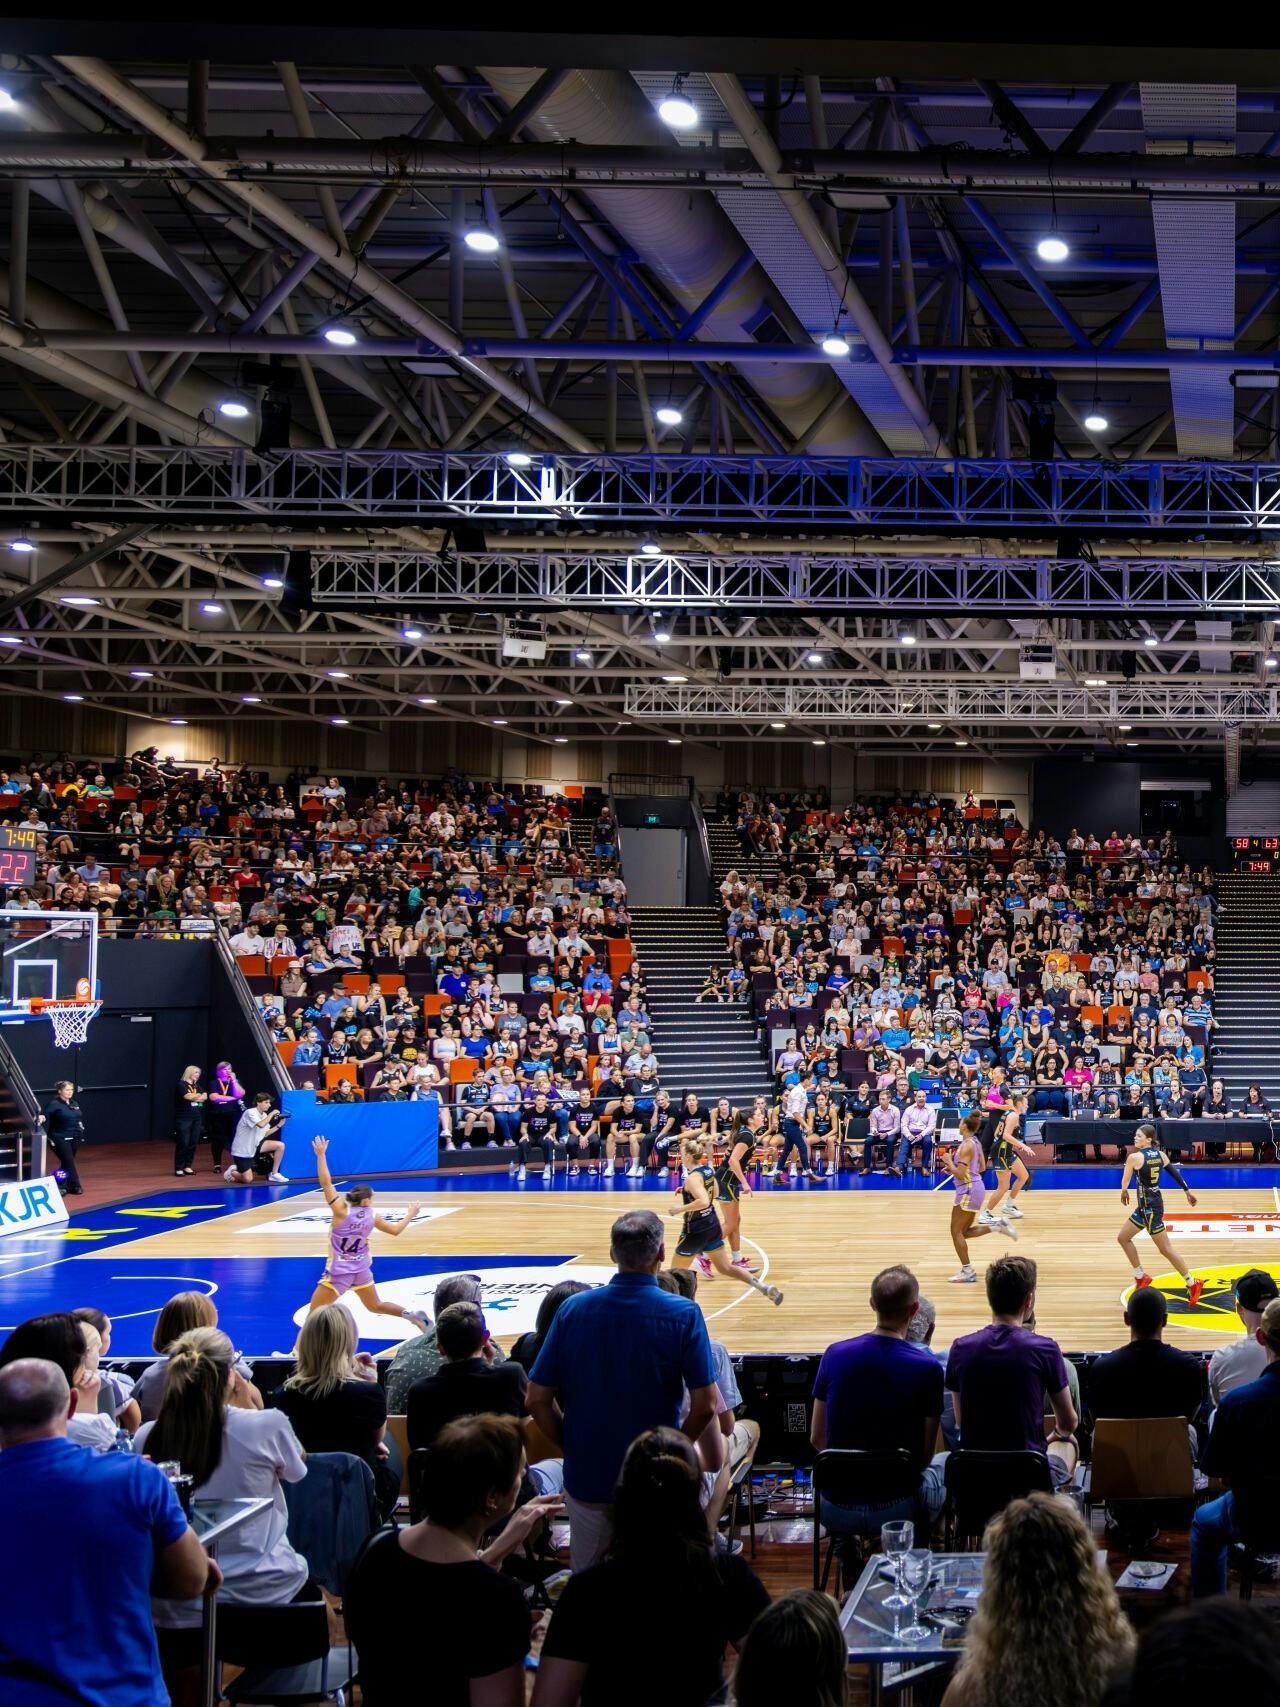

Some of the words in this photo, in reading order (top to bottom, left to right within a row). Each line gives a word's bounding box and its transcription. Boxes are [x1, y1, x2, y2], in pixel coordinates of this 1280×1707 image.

[6, 829, 36, 848] 7:49
[1236, 838, 1249, 848] 58
[1265, 838, 1278, 848] 63
[0, 853, 28, 882] 22
[1248, 862, 1270, 871] 7:49
[1150, 1167, 1160, 1184] 5
[340, 1237, 362, 1254] 14
